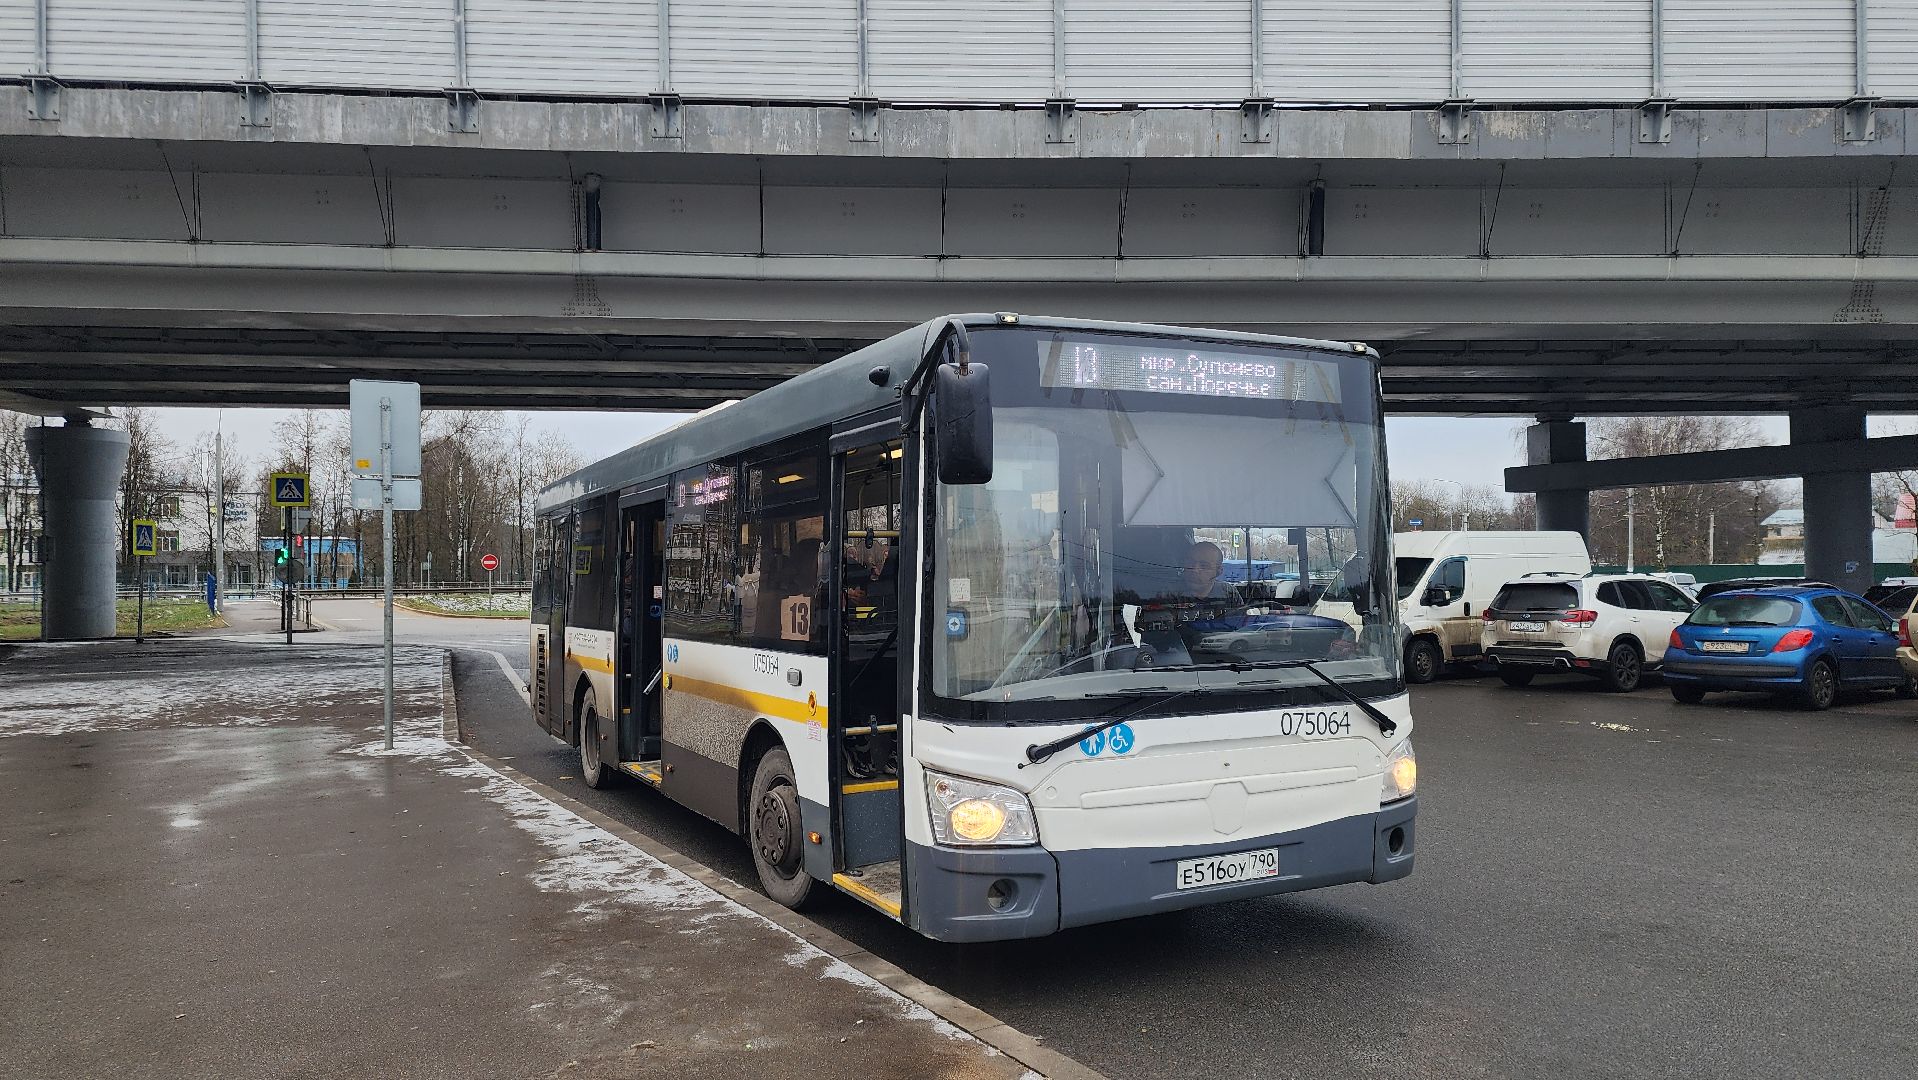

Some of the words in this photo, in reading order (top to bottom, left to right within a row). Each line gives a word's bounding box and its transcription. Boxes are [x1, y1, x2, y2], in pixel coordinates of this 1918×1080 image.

[1074, 346, 1097, 384] 13
[790, 602, 809, 636] 13
[753, 653, 779, 676] 075064
[1280, 711, 1351, 736] 075064
[1250, 852, 1275, 870] 790
